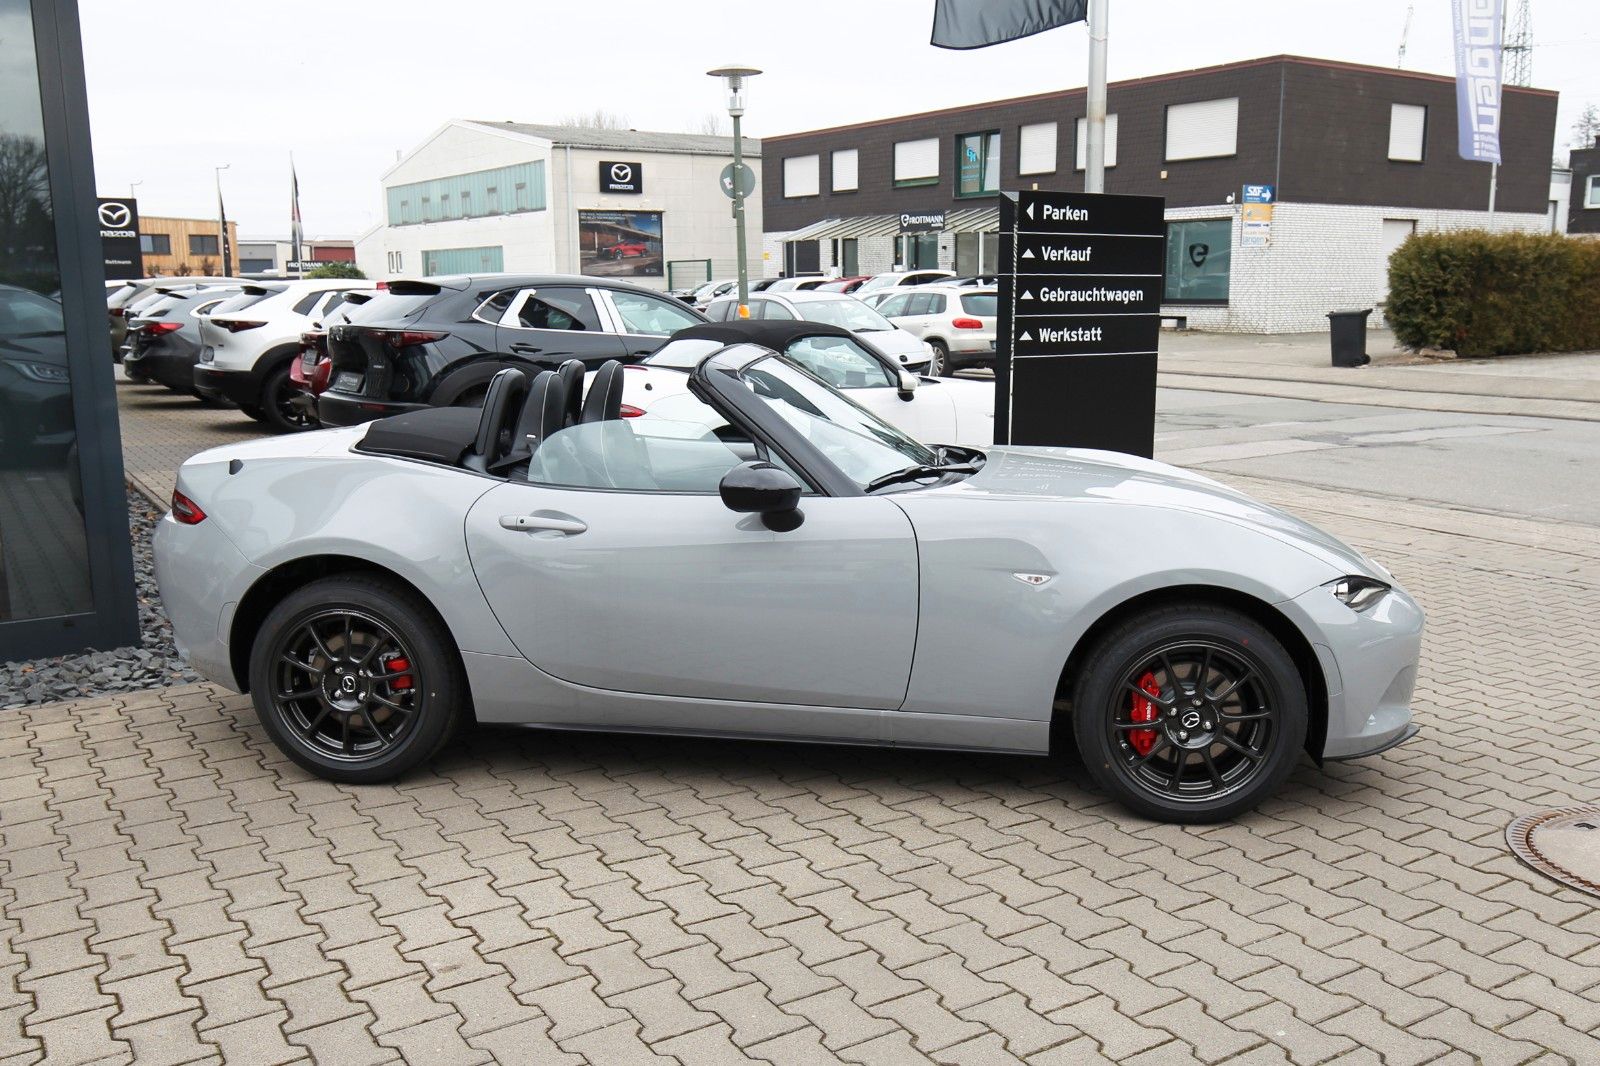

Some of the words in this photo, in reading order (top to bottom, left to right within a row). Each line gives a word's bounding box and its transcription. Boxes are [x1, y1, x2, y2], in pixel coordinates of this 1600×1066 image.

[1043, 204, 1089, 221] Parken
[1042, 246, 1092, 262] Verkauf
[1040, 287, 1144, 304] Gebrauchtwagen
[1039, 327, 1102, 342] Werkstatt
